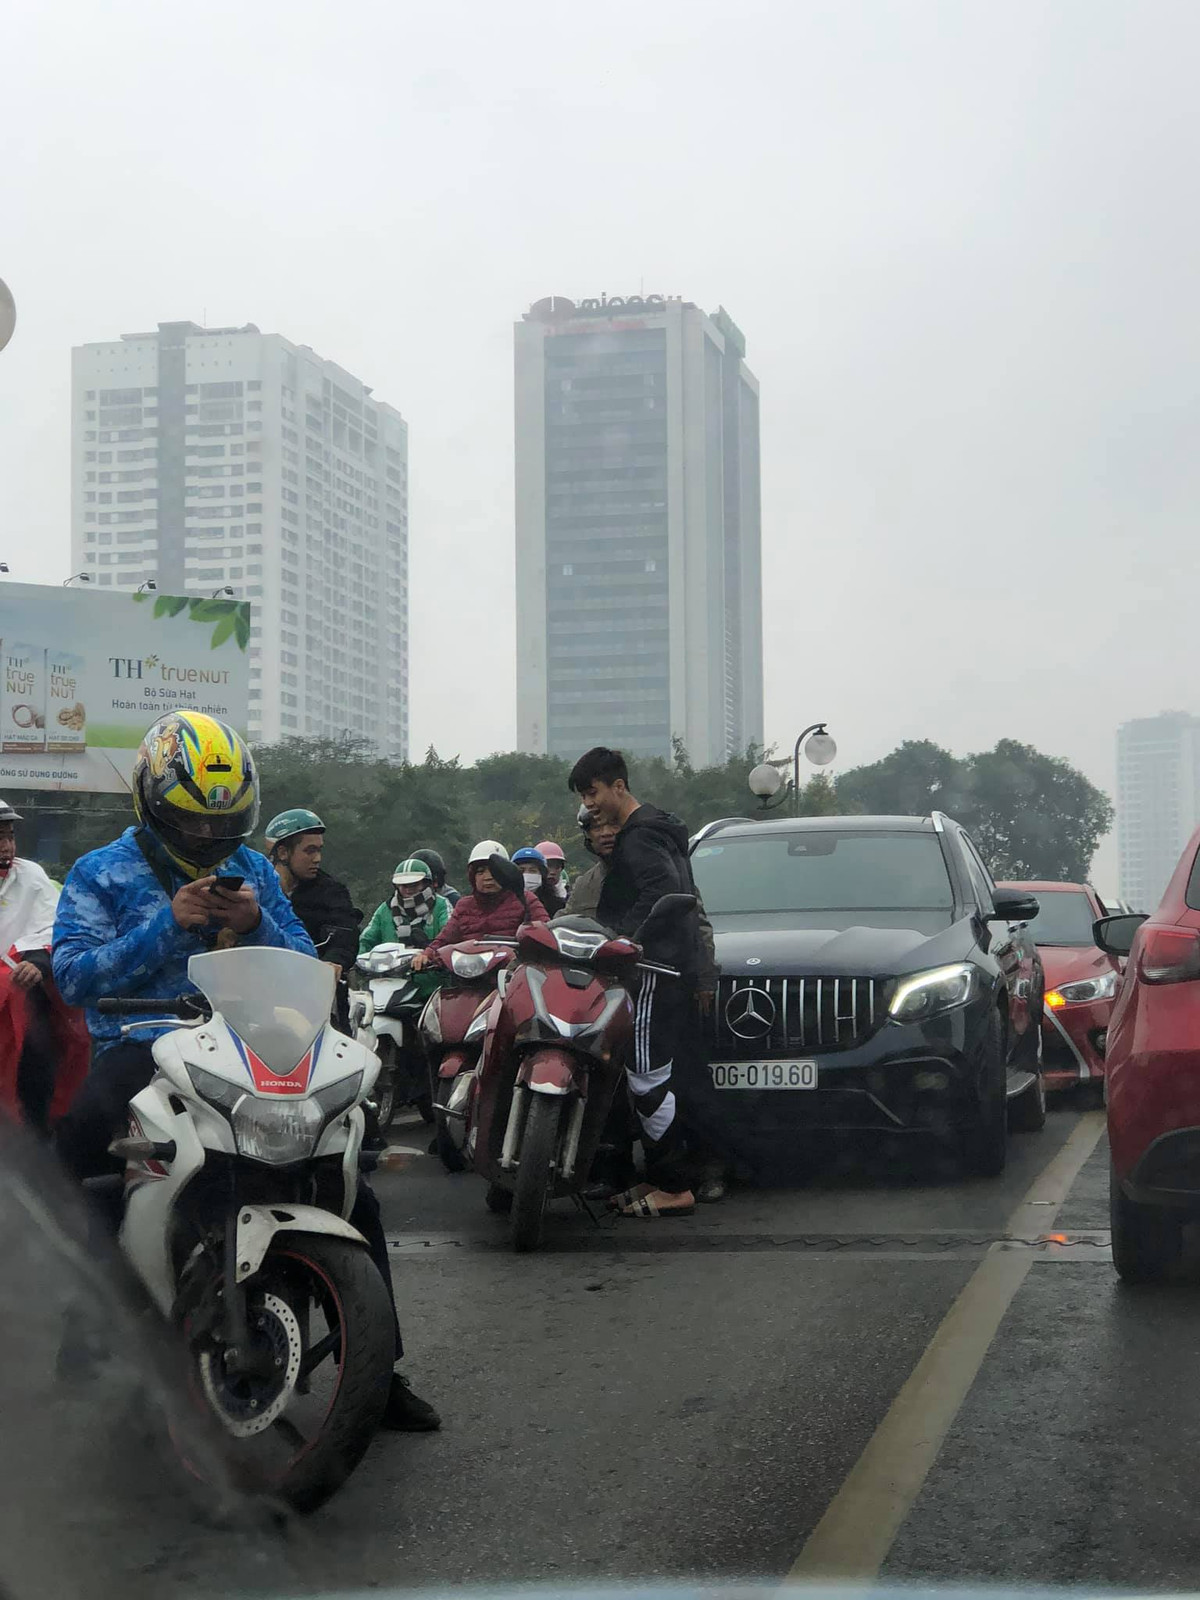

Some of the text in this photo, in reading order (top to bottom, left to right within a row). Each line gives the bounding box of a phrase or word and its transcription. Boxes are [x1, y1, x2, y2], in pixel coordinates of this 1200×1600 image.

[6, 667, 35, 683] true
[109, 657, 143, 680] TH
[51, 673, 77, 688] true
[6, 682, 34, 696] NUT
[51, 687, 75, 700] NUT
[260, 1080, 303, 1088] HONDA
